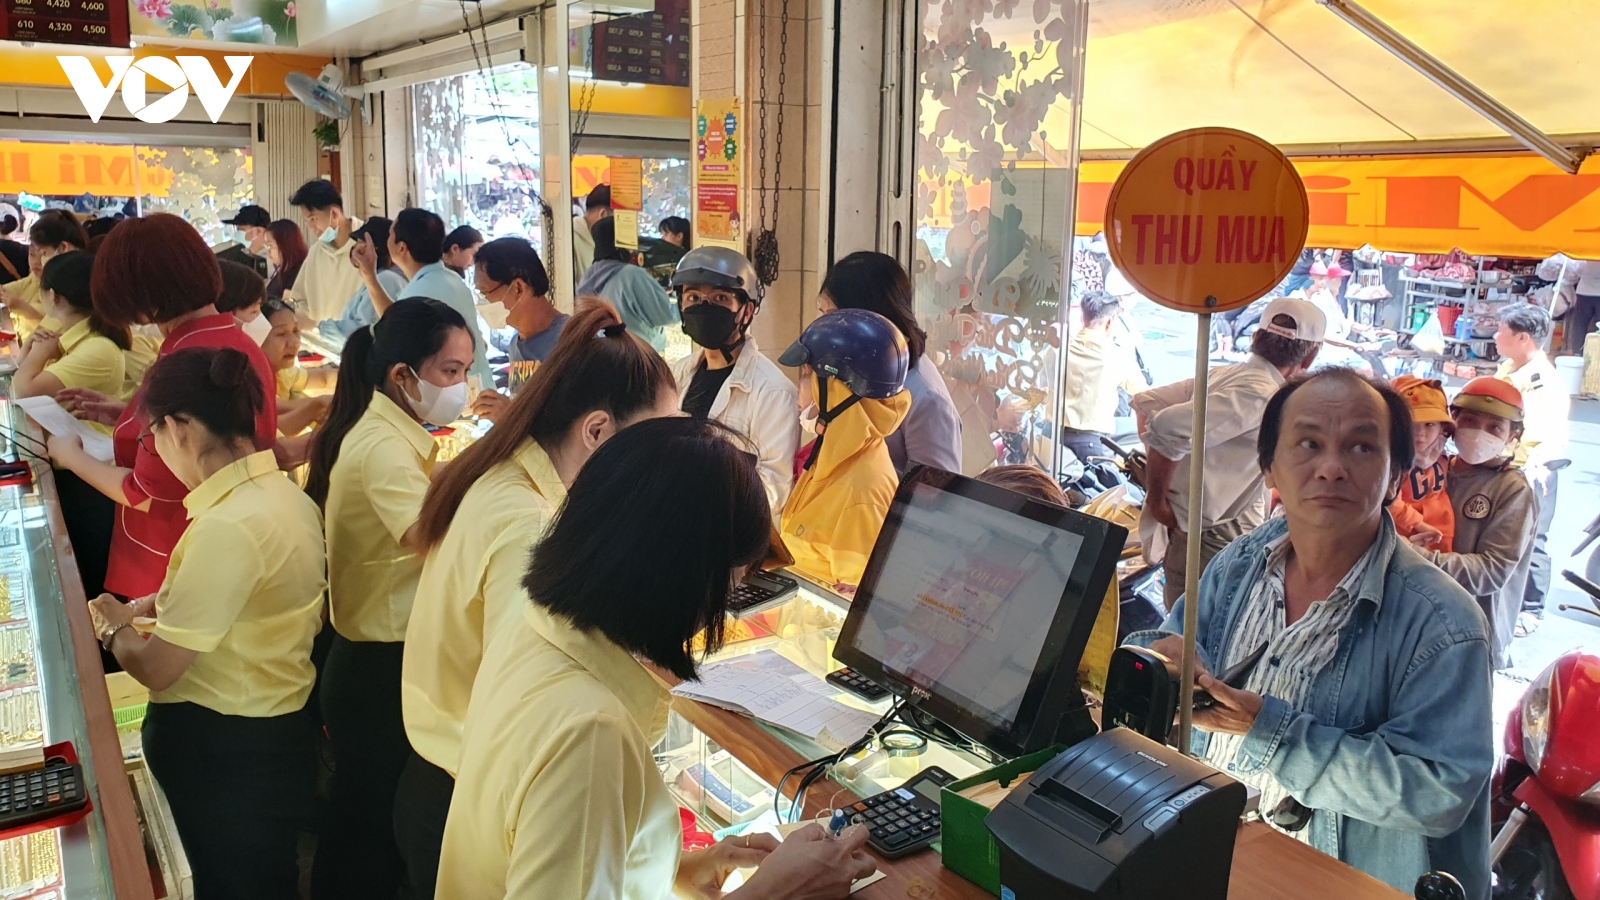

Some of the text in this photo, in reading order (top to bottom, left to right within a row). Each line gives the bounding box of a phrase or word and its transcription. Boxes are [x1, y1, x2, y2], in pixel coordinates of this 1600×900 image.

[81, 2, 105, 11] 4,600
[17, 20, 106, 34] 610 4,320 4,500
[1173, 143, 1258, 196] QUẦY
[1131, 215, 1286, 265] THU MUA
